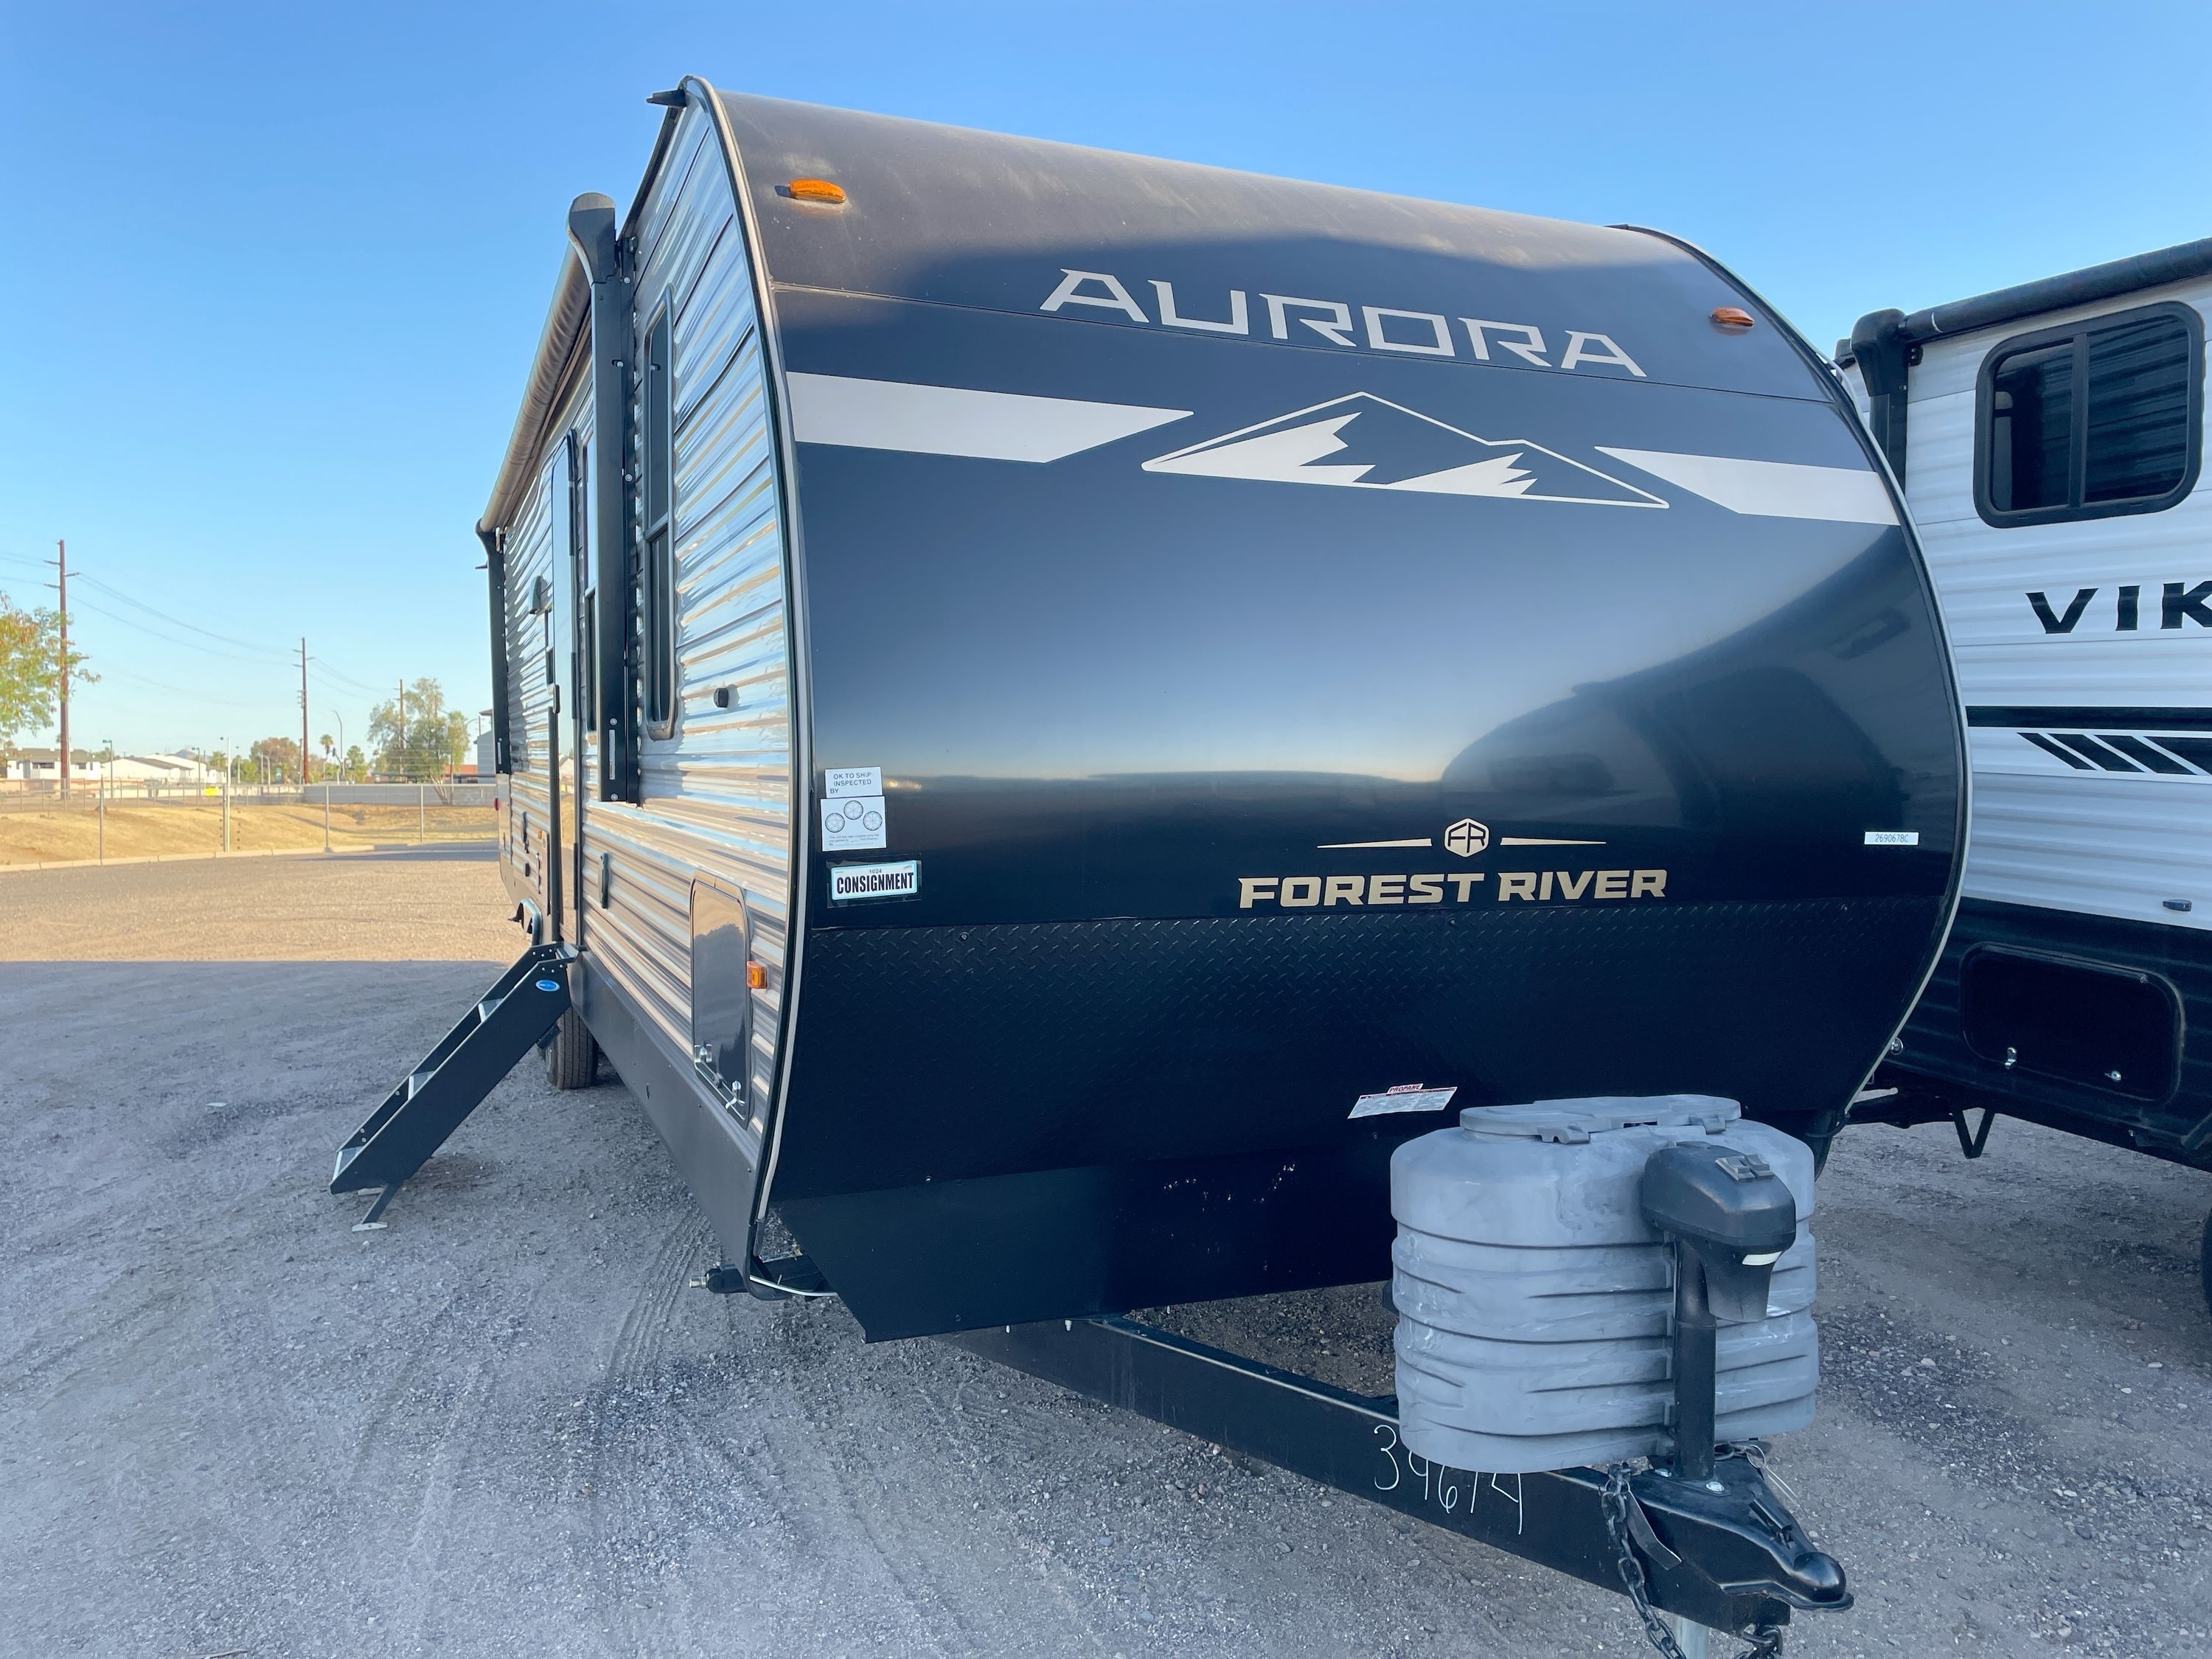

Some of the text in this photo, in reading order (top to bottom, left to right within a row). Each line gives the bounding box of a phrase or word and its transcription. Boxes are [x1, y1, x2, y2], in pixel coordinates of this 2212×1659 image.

[1040, 268, 1647, 378] AURORA
[833, 779, 872, 787] INSPECTED
[836, 872, 914, 894] CONSIGNMENT
[1237, 869, 1668, 909] FOREST RIVER
[1389, 1085, 1422, 1093] PROPANE
